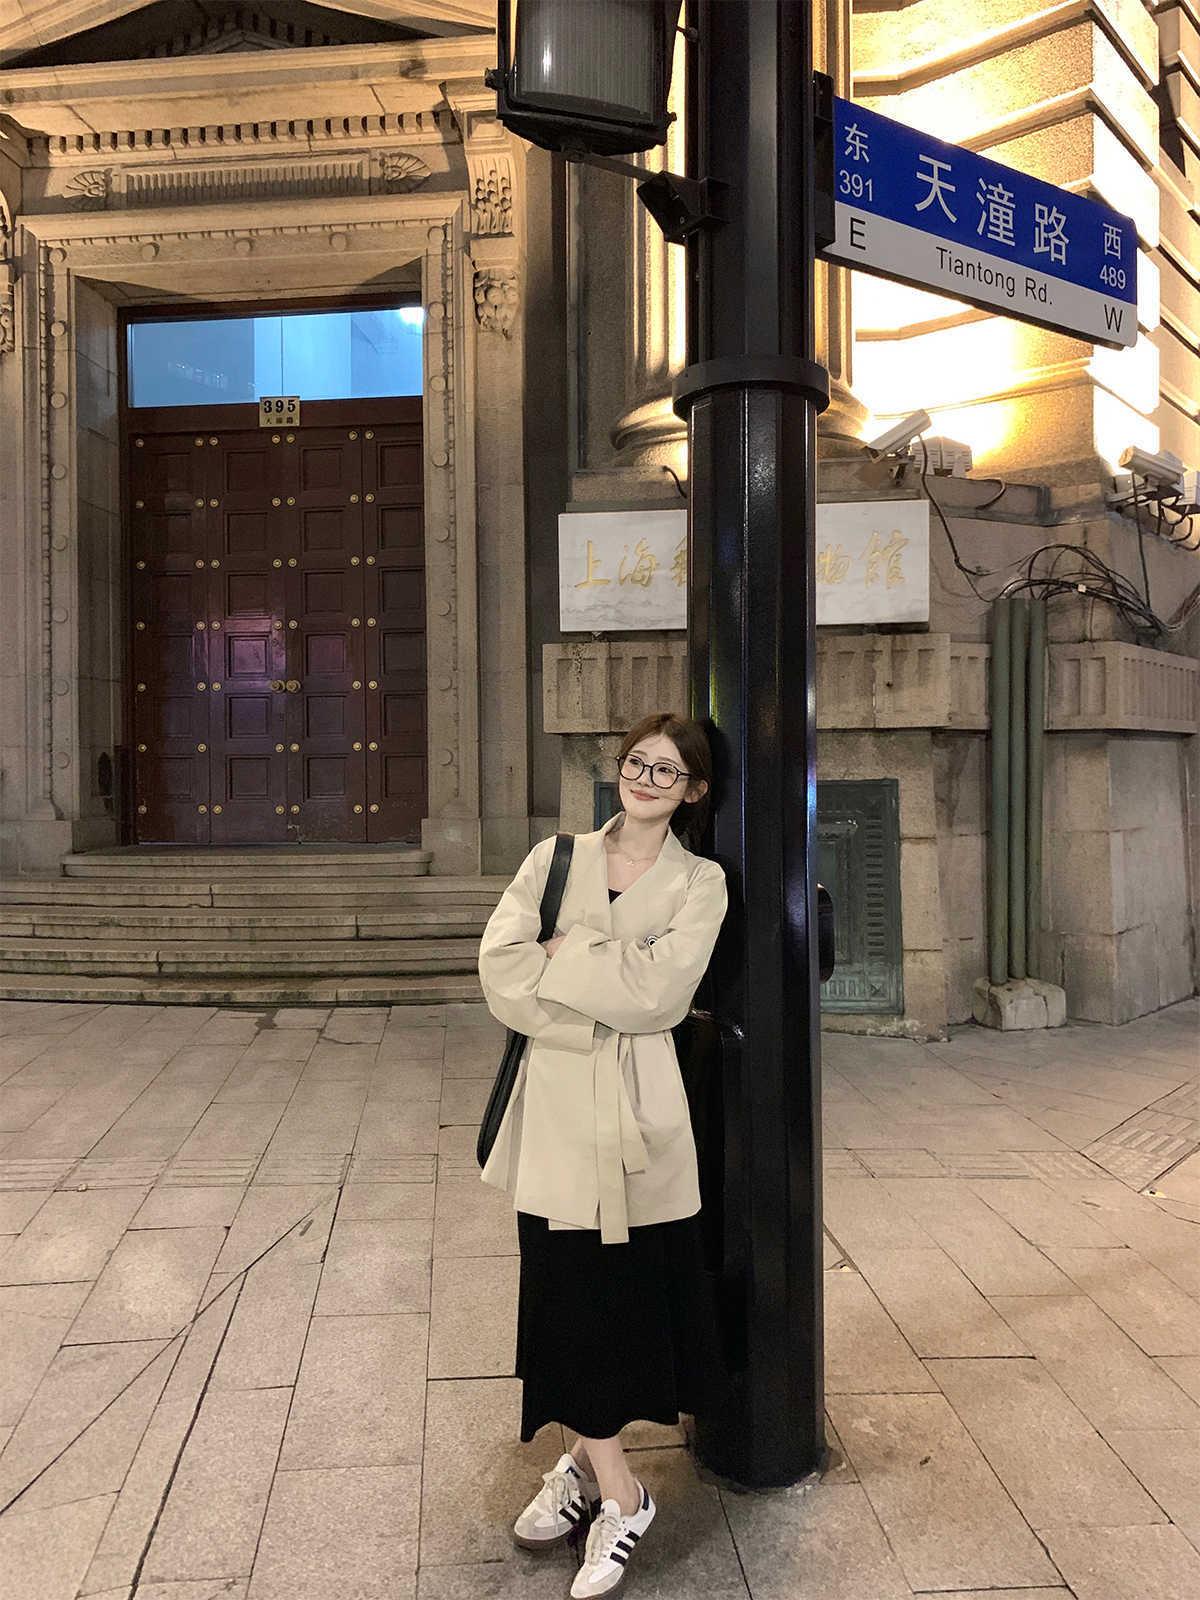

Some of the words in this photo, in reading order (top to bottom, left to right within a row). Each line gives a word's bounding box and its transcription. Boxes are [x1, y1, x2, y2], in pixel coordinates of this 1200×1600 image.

[844, 123, 869, 163] 东
[839, 170, 873, 202] 391
[914, 153, 1070, 266] 天潼路
[850, 217, 867, 251] E
[1102, 222, 1122, 260] 西
[936, 246, 1016, 298] Tiantong
[1025, 277, 1053, 305] Rd.
[1099, 266, 1126, 290] 489
[1104, 304, 1123, 334] W
[264, 399, 296, 413] 395
